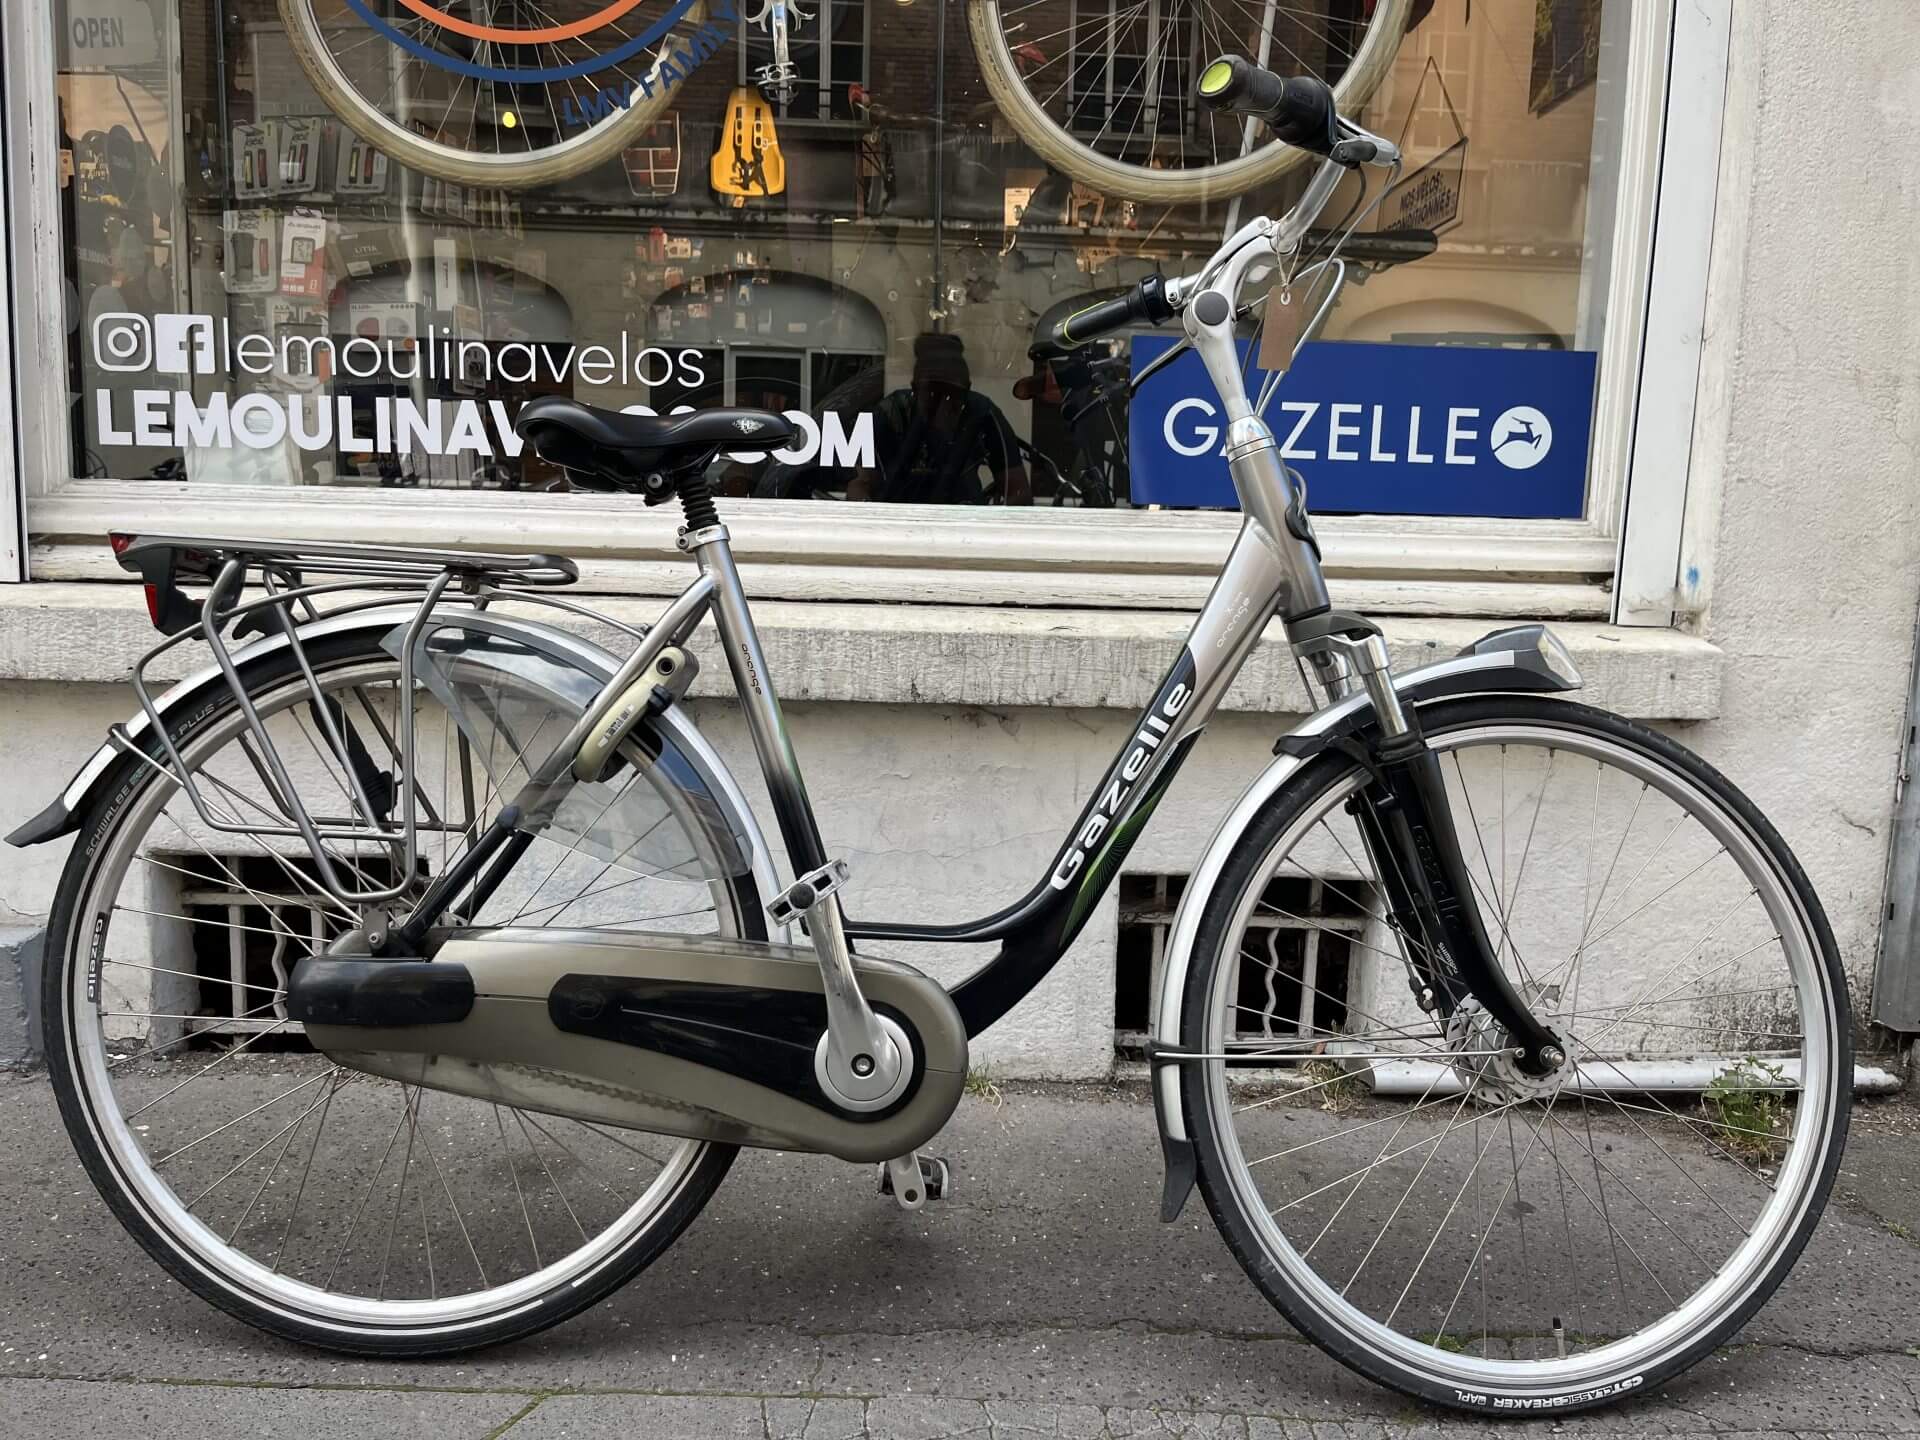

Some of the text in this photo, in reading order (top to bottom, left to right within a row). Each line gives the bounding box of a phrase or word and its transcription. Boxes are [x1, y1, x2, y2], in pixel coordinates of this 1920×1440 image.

[73, 17, 125, 48] OPEN
[562, 80, 631, 126] LMV
[223, 317, 705, 388] lemoulinavelos
[96, 388, 876, 468] LEMOULINAVOM
[1163, 397, 1481, 465] GZELLE
[178, 703, 216, 736] PLUS
[85, 786, 130, 858] SCHWALBE
[1050, 682, 1193, 891] Gazelle
[87, 918, 104, 999] Gazelle
